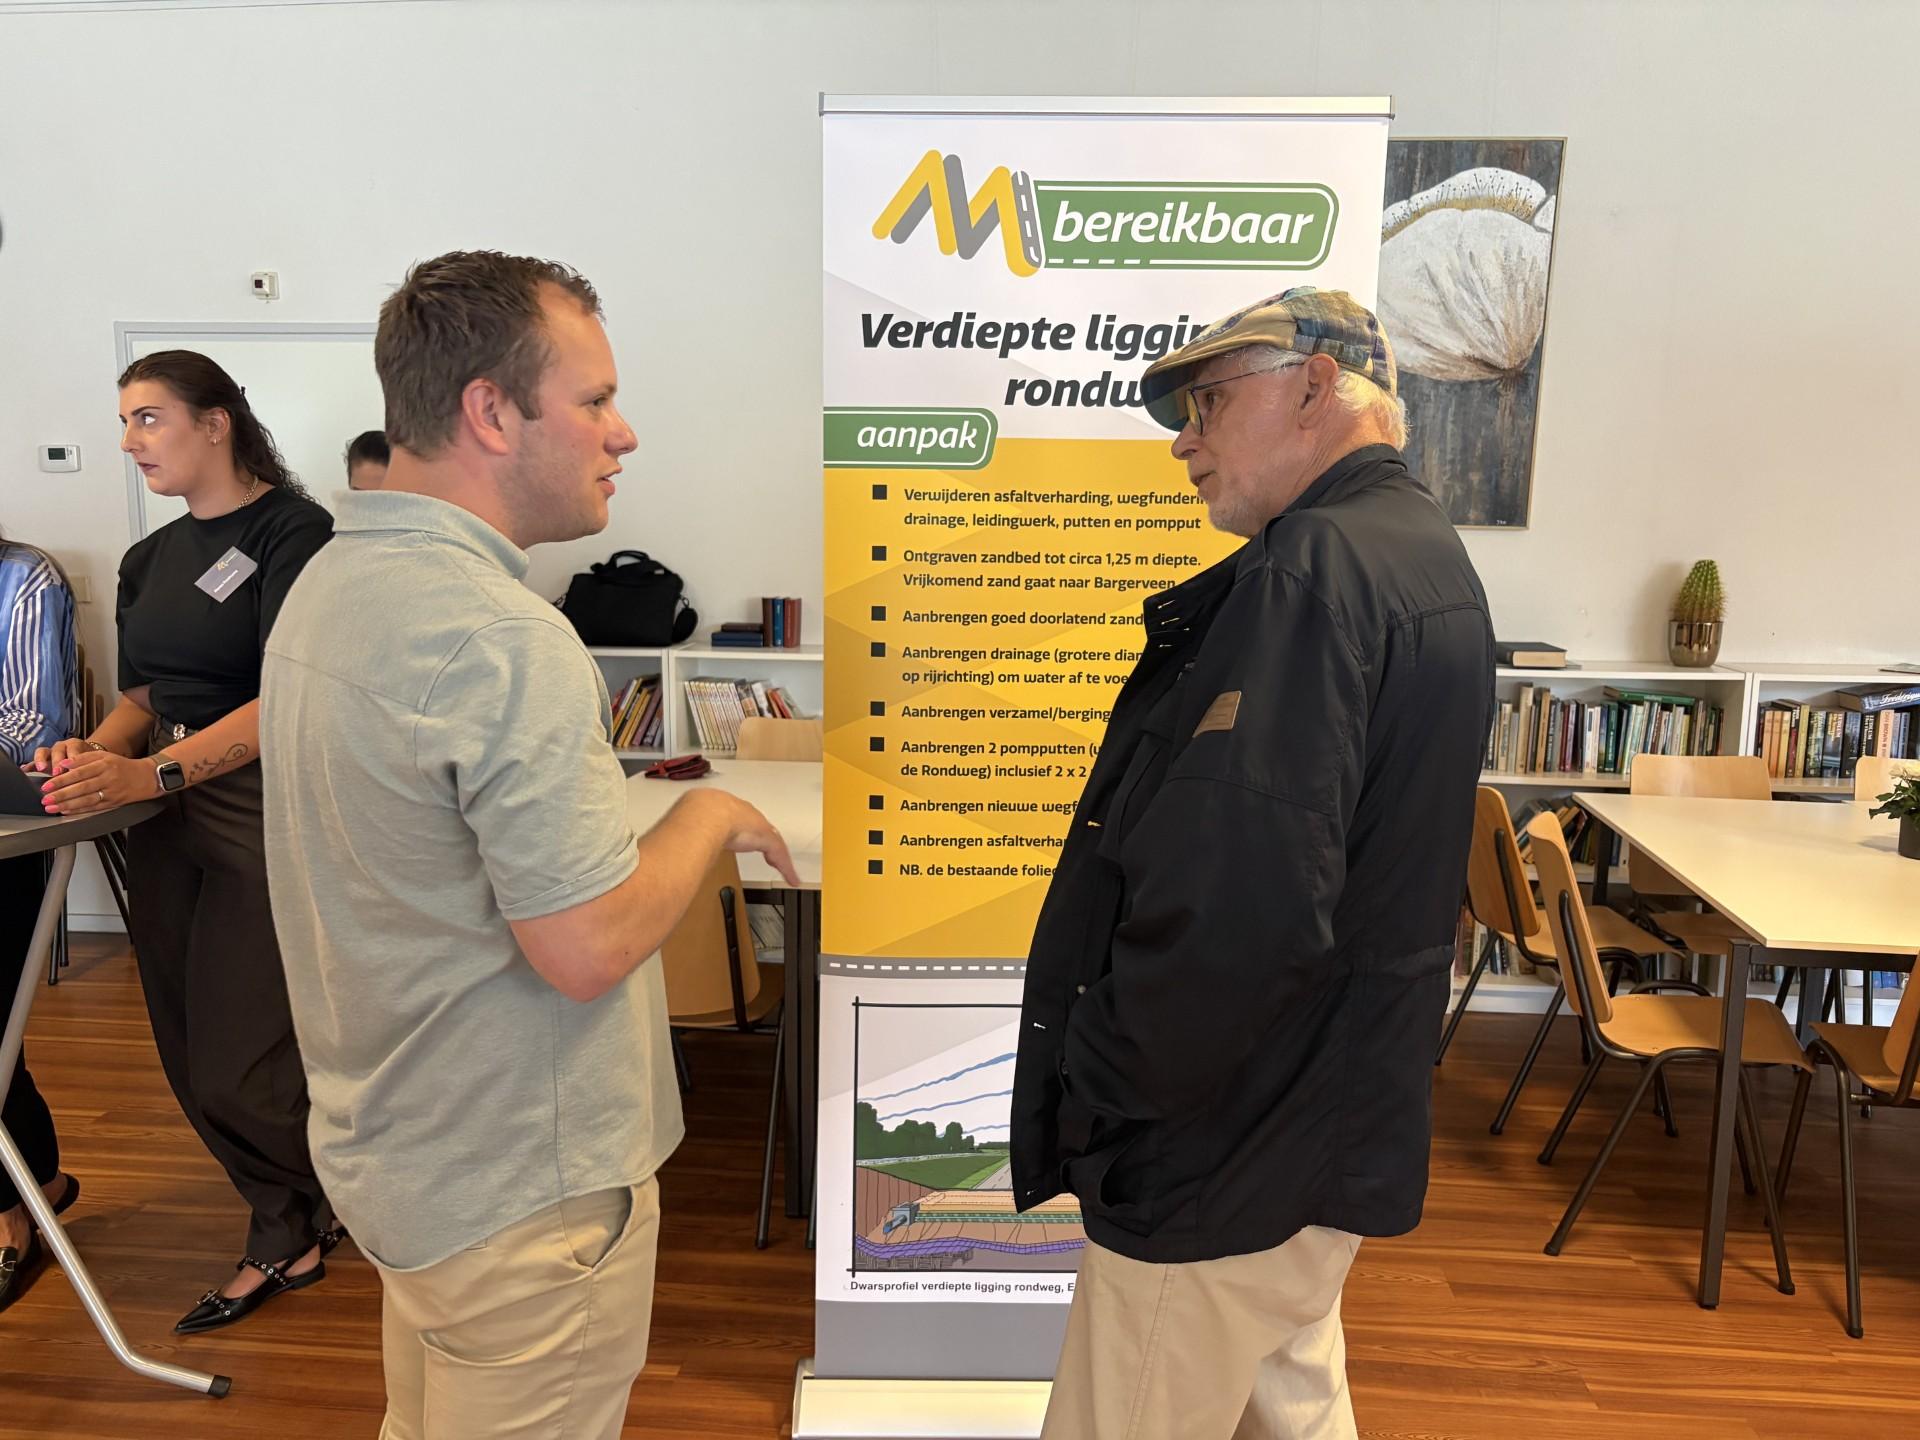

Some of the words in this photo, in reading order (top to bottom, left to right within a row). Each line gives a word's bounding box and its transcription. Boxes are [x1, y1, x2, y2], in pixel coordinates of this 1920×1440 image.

[1052, 200, 1314, 246] bereikbaar
[861, 312, 1076, 359] Verdiepte
[857, 421, 977, 455] aanpak
[904, 488, 990, 504] Verwijderen
[994, 490, 1113, 507] asfaltverharding,
[904, 512, 969, 529] drainage,
[972, 513, 1059, 530] leidingwerk,
[1063, 516, 1111, 531] putten
[1114, 518, 1132, 528] en
[1135, 518, 1202, 532] pompput
[903, 549, 977, 566] Ontgraven
[980, 551, 1041, 565] zandbed
[1044, 553, 1066, 565] tot
[1069, 552, 1102, 565] circa
[1105, 552, 1132, 567] 1,25
[1135, 555, 1149, 565] m
[1152, 553, 1201, 569] diepte.
[903, 573, 984, 589] Vrijkomend
[987, 575, 1021, 588] zand
[1024, 577, 1056, 591] gaat
[1059, 578, 1091, 588] naar
[1094, 576, 1176, 592] Bargerveen
[902, 610, 988, 626] Aanbrengen
[991, 611, 1026, 627] goed
[1029, 611, 1106, 625] doorlatend
[1109, 613, 1144, 625] zand
[902, 646, 987, 663] Aanbrengen
[990, 647, 1051, 663] drainage
[1054, 648, 1111, 664] (grotere
[902, 672, 920, 685] op
[923, 669, 995, 686] rijrichting)
[997, 673, 1020, 683] om
[1023, 672, 1066, 684] water
[1068, 671, 1083, 684] af
[1086, 673, 1101, 684] te
[901, 705, 986, 721] Aanbrengen
[989, 707, 1111, 723] verzamel/berging
[900, 741, 985, 757] Aanbrengen
[988, 742, 997, 754] 2
[1000, 743, 1086, 757] pompputten
[900, 763, 918, 776] de
[921, 764, 992, 780] Rondweg)
[995, 764, 1053, 777] inclusief
[1055, 765, 1063, 777] 2
[1066, 768, 1075, 778] x
[1078, 766, 1087, 777] 2
[900, 799, 984, 815] Aanbrengen
[987, 800, 1038, 812] nieuwe
[1041, 801, 1078, 815] wegf
[899, 834, 983, 850] Aanbrengen
[986, 834, 1065, 848] asfaltverha
[899, 864, 923, 876] NB.
[926, 863, 944, 876] de
[947, 863, 1018, 876] bestaande
[850, 1280, 919, 1293] Dwarsprofiel
[921, 1281, 972, 1294] verdiepte
[974, 1282, 1011, 1295] ligging
[1014, 1282, 1064, 1294] rondweg,
